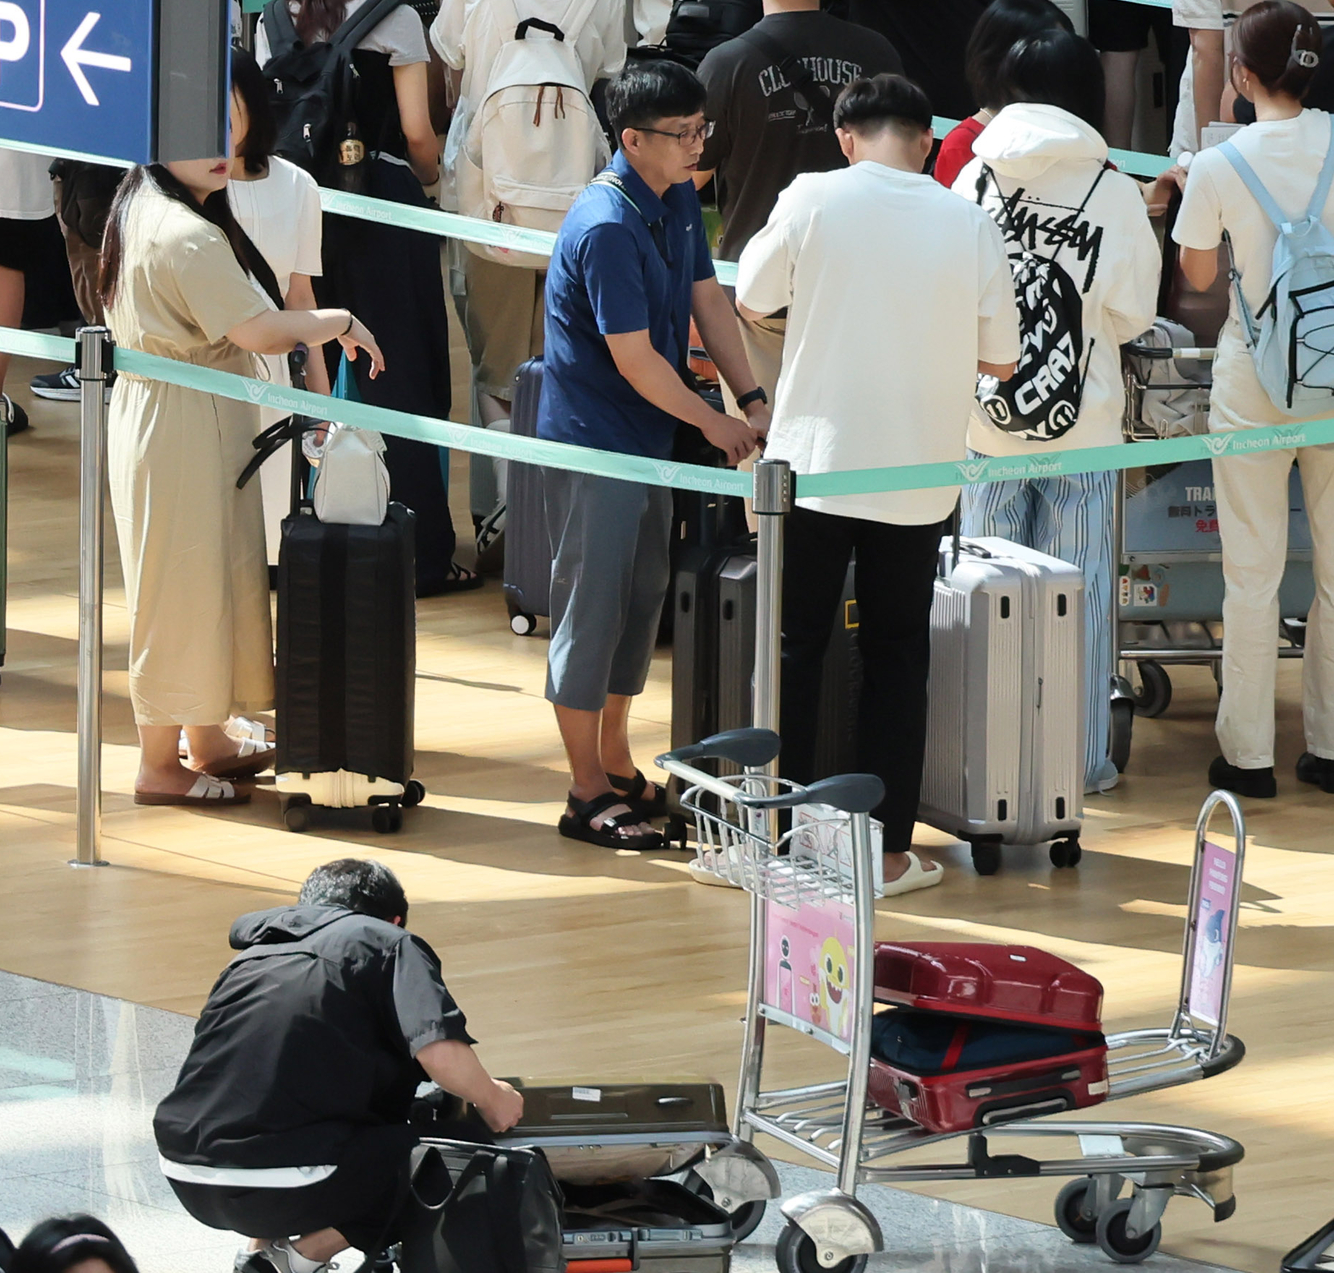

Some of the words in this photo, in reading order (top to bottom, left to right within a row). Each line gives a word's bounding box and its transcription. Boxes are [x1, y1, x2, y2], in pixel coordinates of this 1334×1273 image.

[268, 392, 297, 407] Incheon
[301, 400, 327, 416] Airport
[1233, 437, 1270, 451] Incheon
[1273, 433, 1305, 447] Airport
[989, 464, 1026, 478] Incheon
[1028, 461, 1061, 475] Airport
[680, 473, 712, 486] Incheon
[715, 478, 744, 493] Airport
